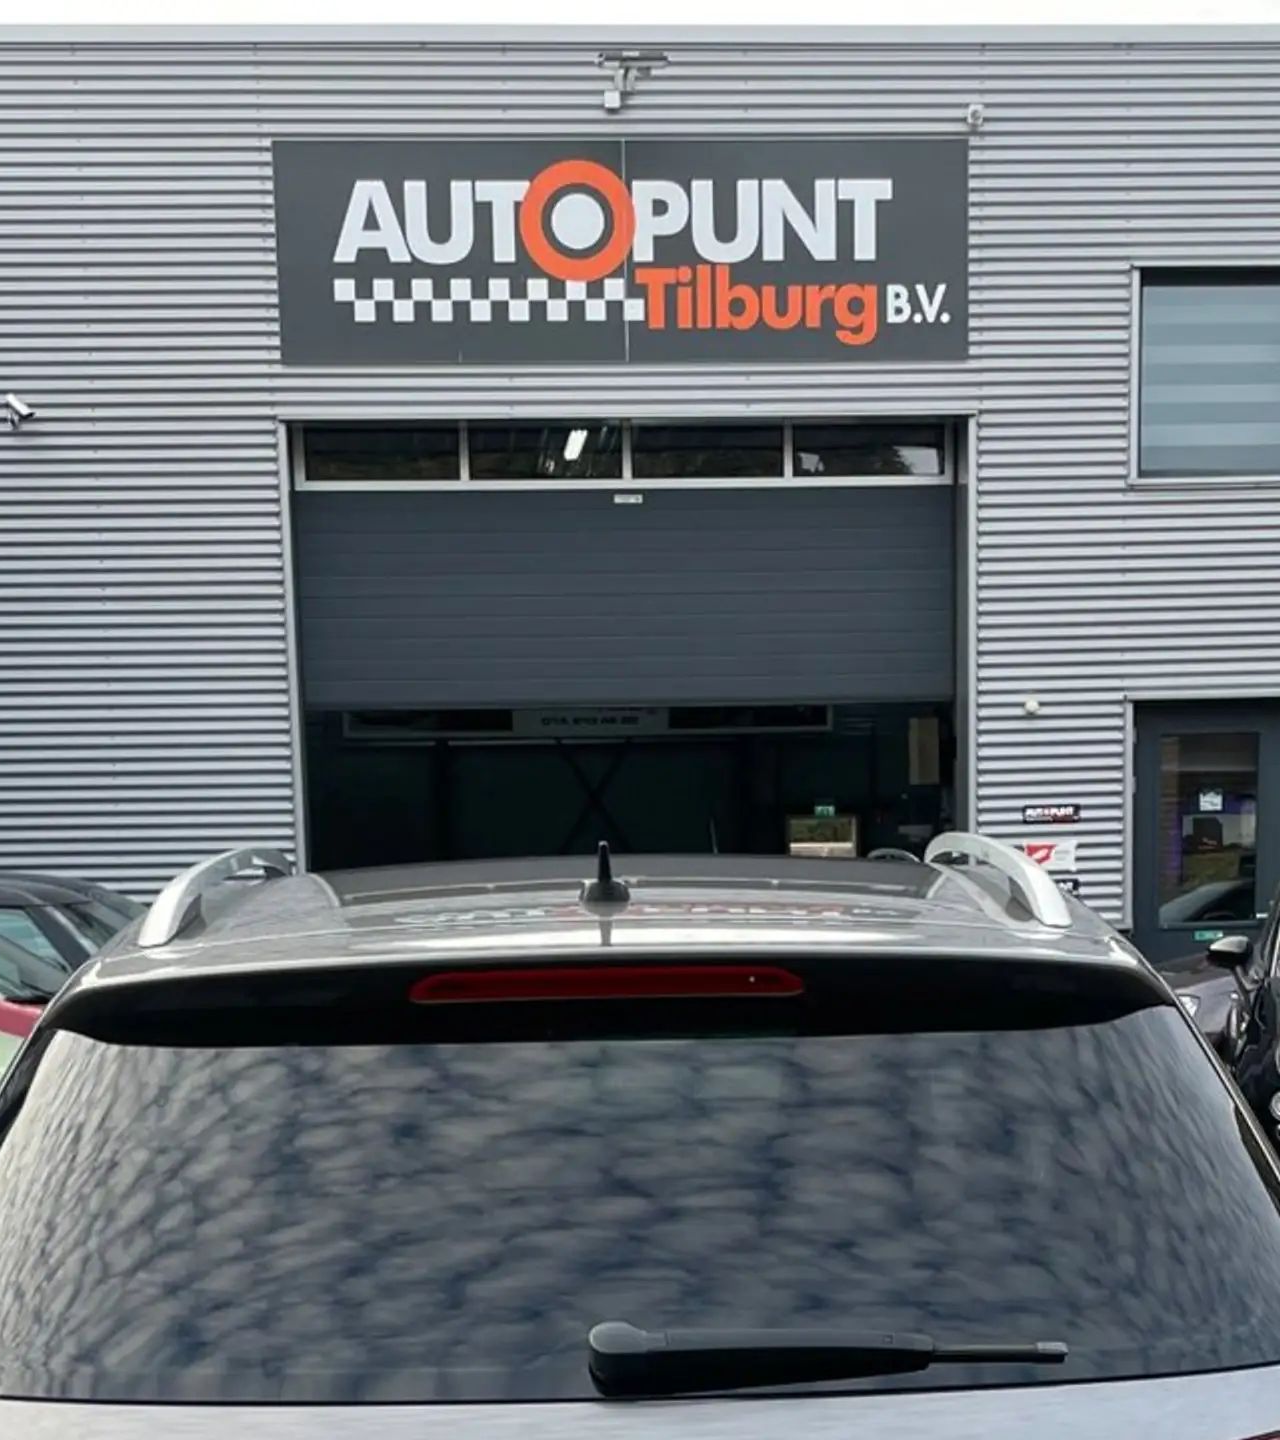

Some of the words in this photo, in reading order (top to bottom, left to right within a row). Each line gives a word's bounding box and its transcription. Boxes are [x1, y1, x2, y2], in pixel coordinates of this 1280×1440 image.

[333, 160, 893, 282] AUTOPUNT
[634, 264, 878, 345] Tilburg
[887, 284, 950, 323] B.V.
